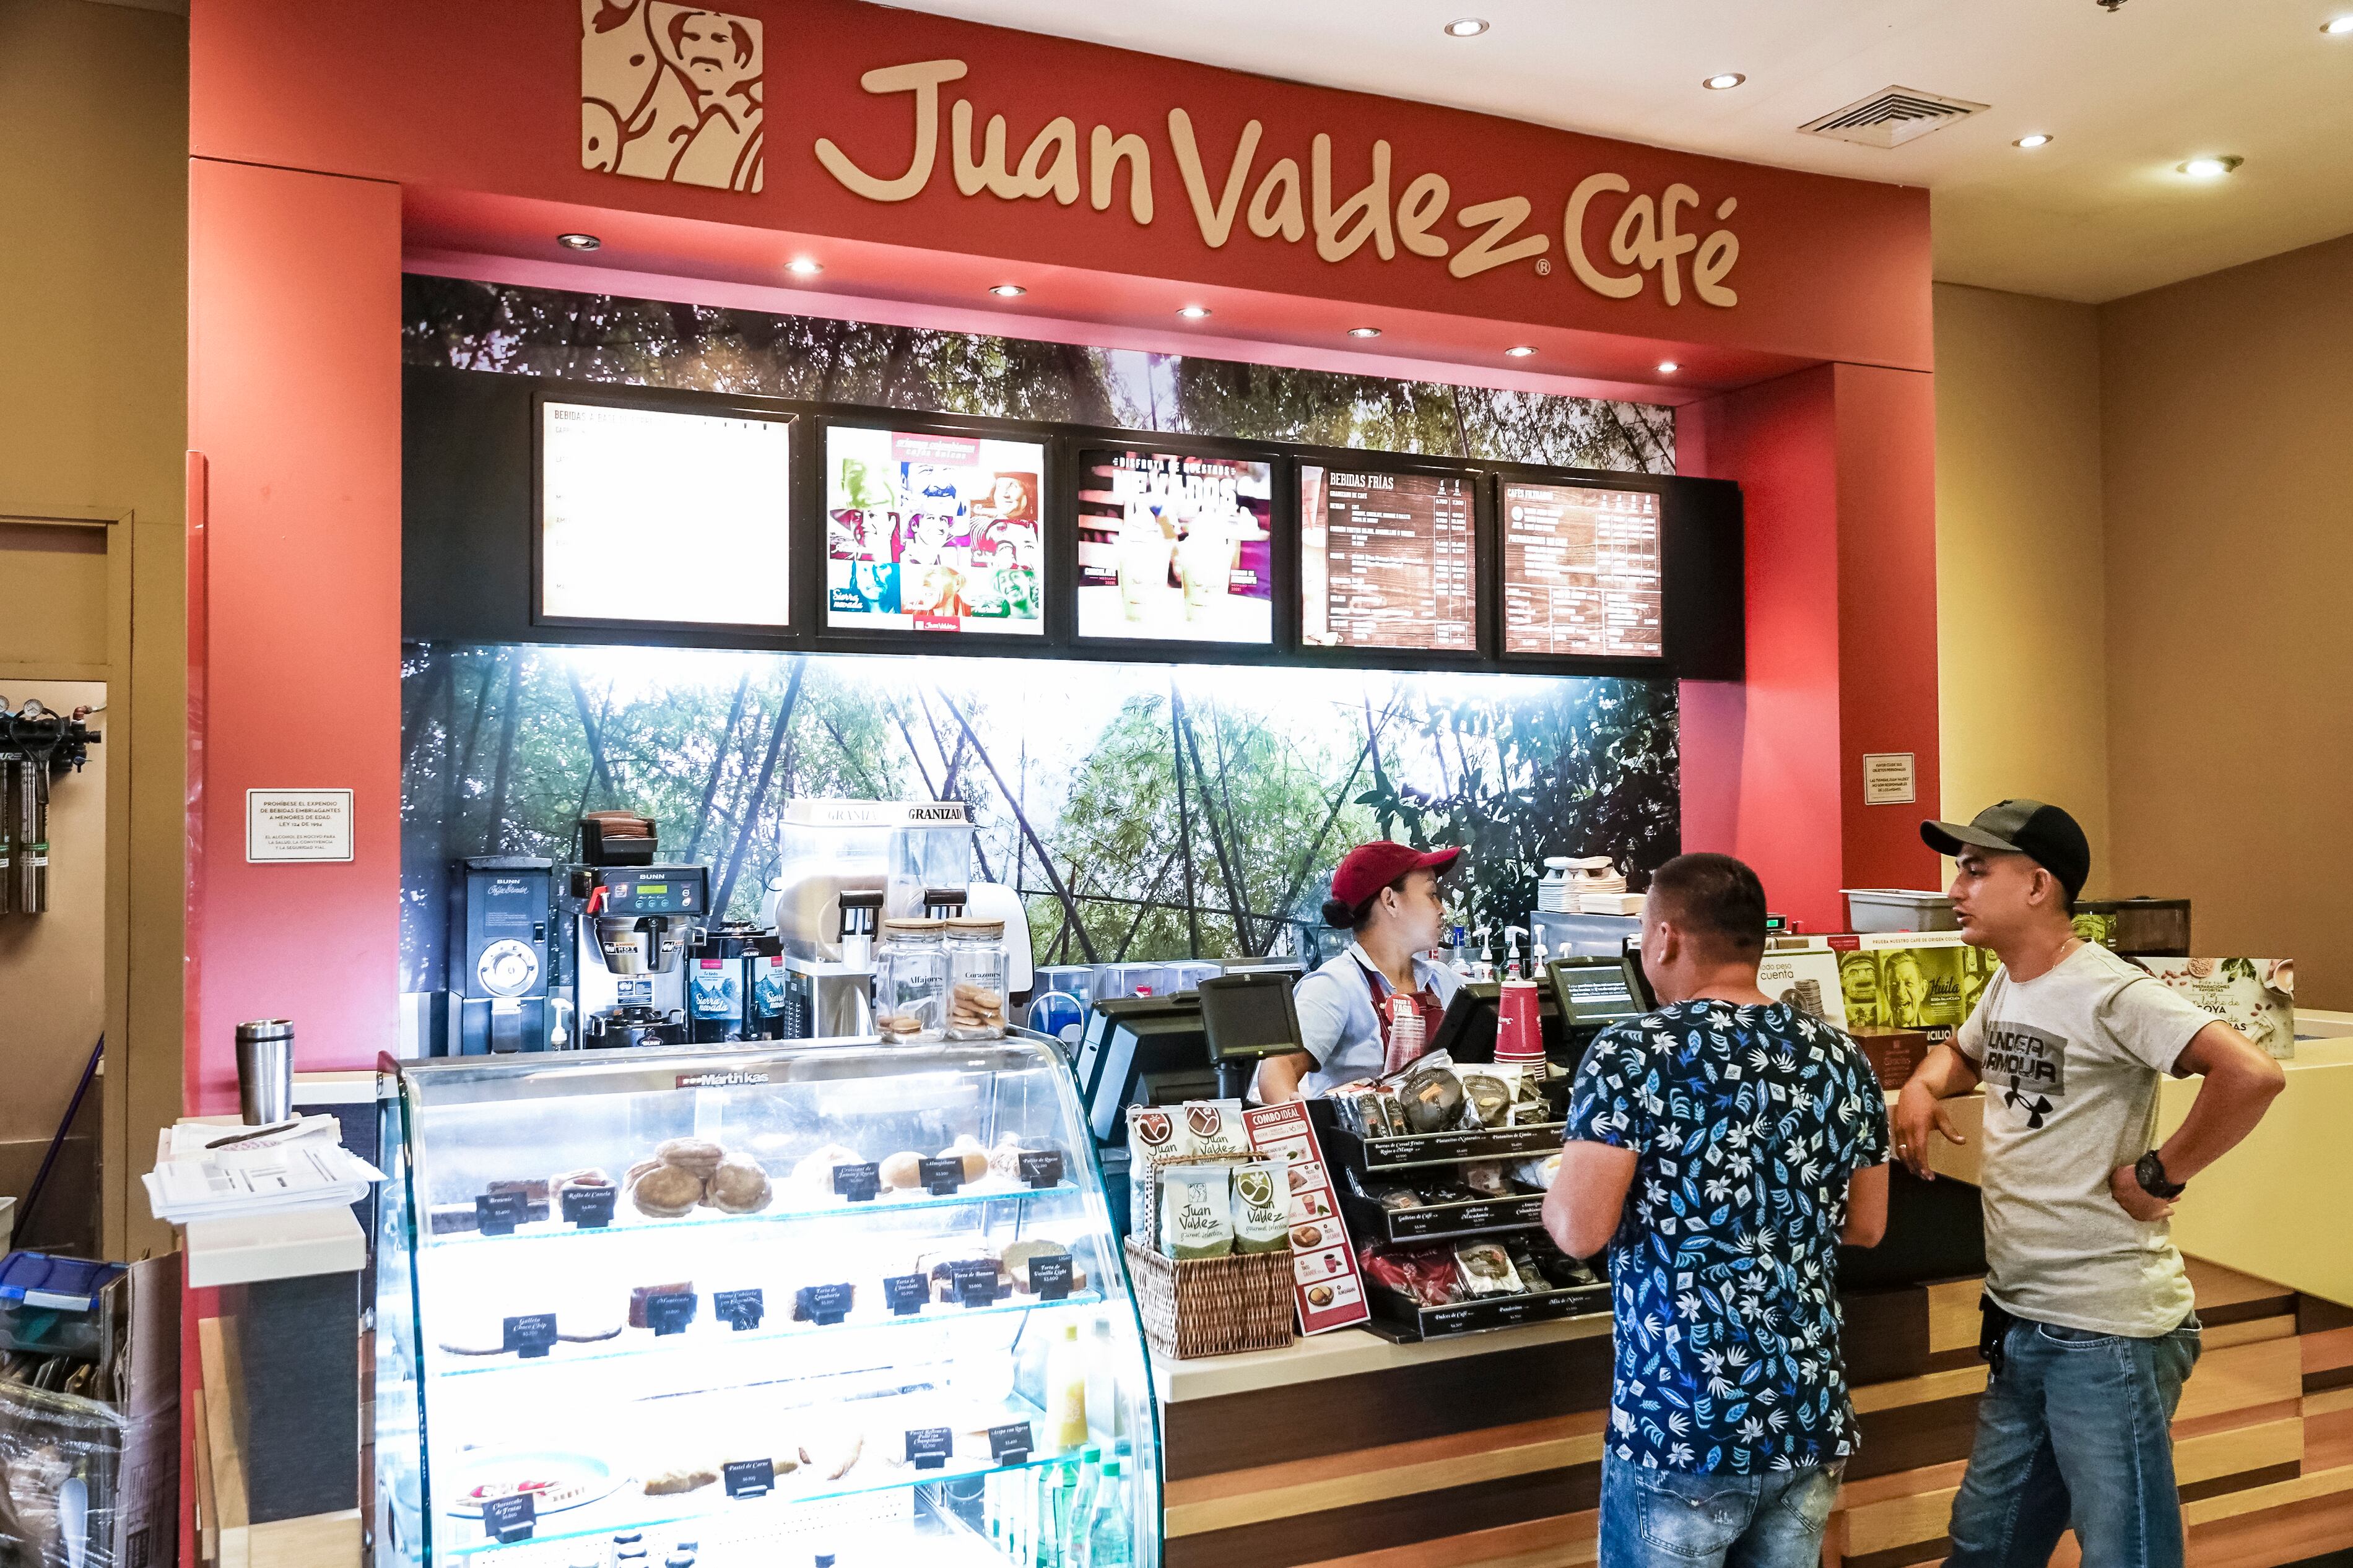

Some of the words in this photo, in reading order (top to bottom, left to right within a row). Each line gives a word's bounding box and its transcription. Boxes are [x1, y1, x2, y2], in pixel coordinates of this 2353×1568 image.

[816, 59, 1155, 225] Juan
[1168, 106, 1549, 279] Valdez
[1564, 173, 1739, 308] Café
[555, 410, 585, 420] BEBIDAS
[1330, 472, 1365, 488] BEBIDAS
[1368, 474, 1394, 489] FRÍAS
[1760, 963, 1774, 971] odo
[1776, 963, 1791, 971] peso
[1760, 969, 1794, 980] cuenta
[910, 976, 943, 985] Alfajores
[1929, 976, 1960, 995] Huila
[696, 993, 720, 1005] Sierra
[2202, 995, 2226, 1006] leche
[2228, 997, 2240, 1006] de
[698, 1000, 728, 1011] nevada
[1252, 1112, 1281, 1125] COMBO
[1280, 1107, 1300, 1119] IDEAL
[1200, 1135, 1229, 1145] Juan
[1458, 1135, 1481, 1143] Naturales
[1148, 1143, 1178, 1157] Juan
[1199, 1144, 1237, 1155] Valdez
[1181, 1204, 1211, 1218] Juan
[1461, 1211, 1489, 1219] Macadamia
[1247, 1211, 1285, 1223] Valdez
[1179, 1217, 1223, 1230] Valdez
[1180, 1232, 1200, 1241] gourmet
[1201, 1230, 1224, 1238] selection
[1052, 1268, 1067, 1277] Light
[816, 1286, 829, 1294] Torta
[895, 1283, 918, 1292] Chocolate
[656, 1296, 690, 1304] Mantecada
[1457, 1310, 1467, 1319] Café
[520, 1317, 541, 1325] Galleta
[532, 1322, 547, 1330] Chip
[728, 1463, 746, 1471] Pastel
[752, 1461, 769, 1469] Carne
[492, 1497, 523, 1511] Cheesecake
[495, 1508, 502, 1516] de
[502, 1505, 522, 1515] Frutas
